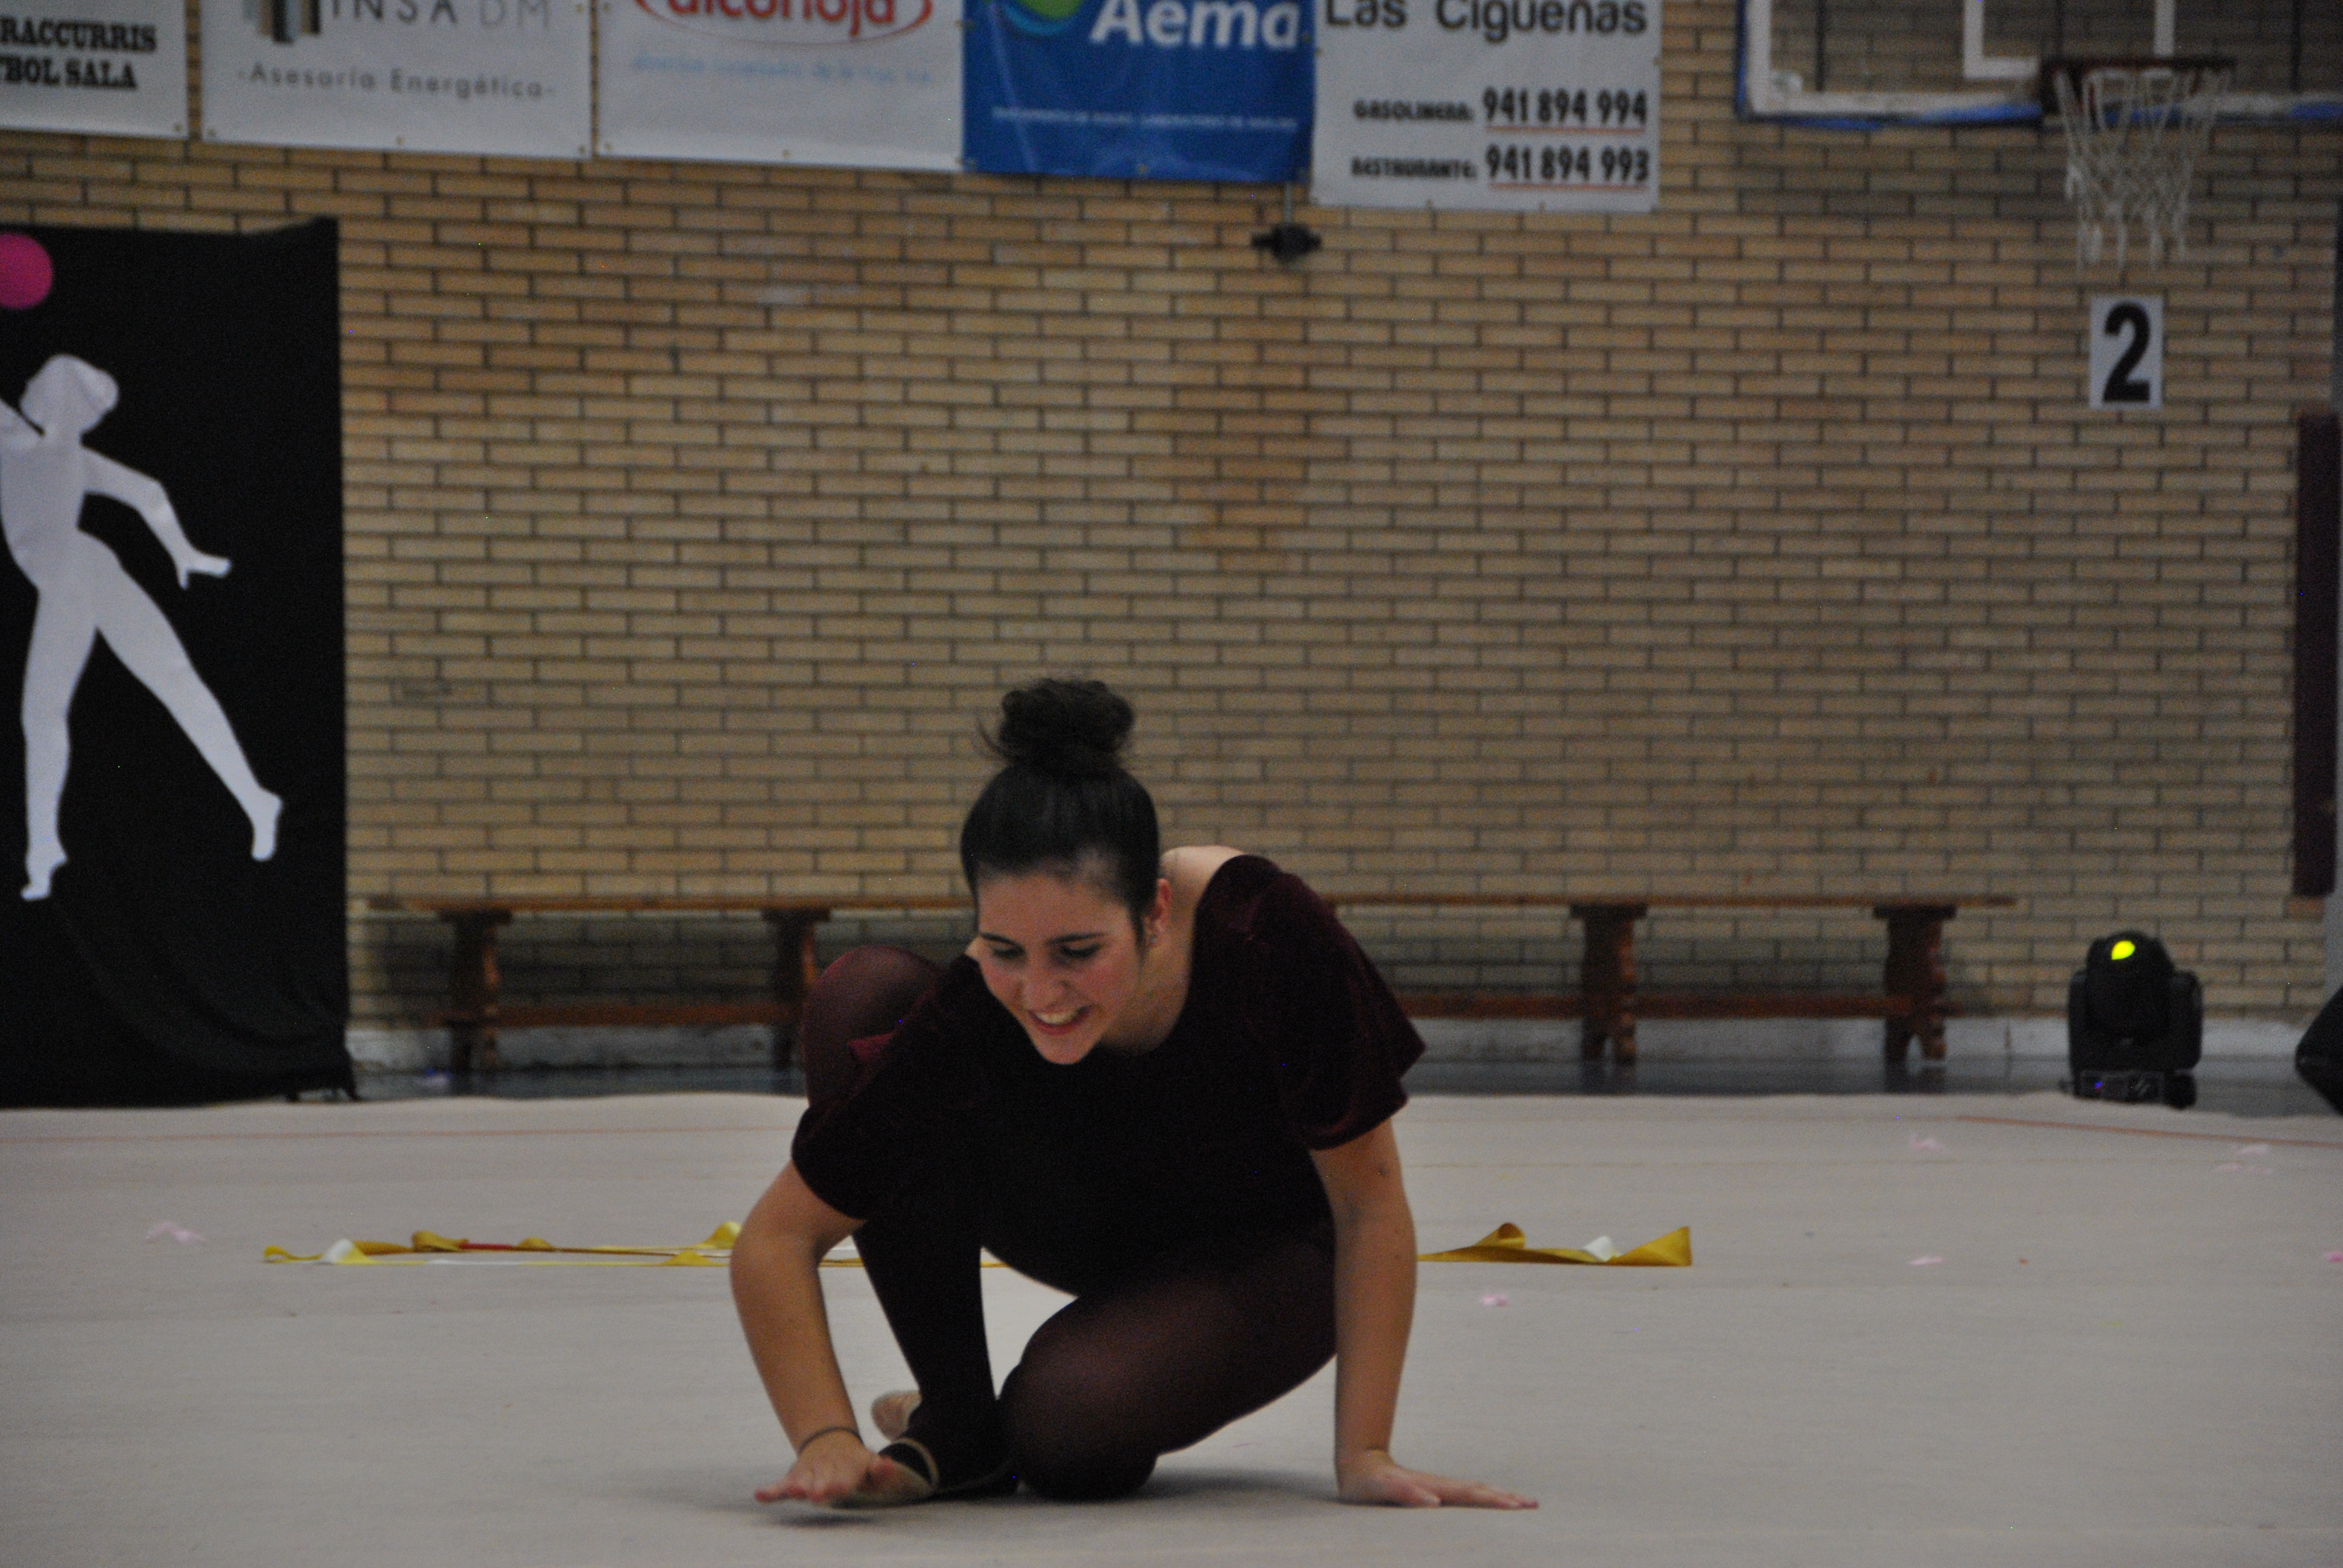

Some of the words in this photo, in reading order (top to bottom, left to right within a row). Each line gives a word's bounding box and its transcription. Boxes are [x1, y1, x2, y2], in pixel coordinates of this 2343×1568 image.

[1089, 0, 1301, 48] Aema
[1326, 0, 1406, 27] Las
[65, 59, 137, 90] SALA
[1483, 87, 1529, 123] 941
[1538, 88, 1587, 123] 894
[1596, 89, 1647, 125] 994
[1486, 143, 1531, 180] 941
[1541, 145, 1590, 181] 894
[1601, 146, 1650, 182] 993
[2103, 302, 2152, 402] 2
